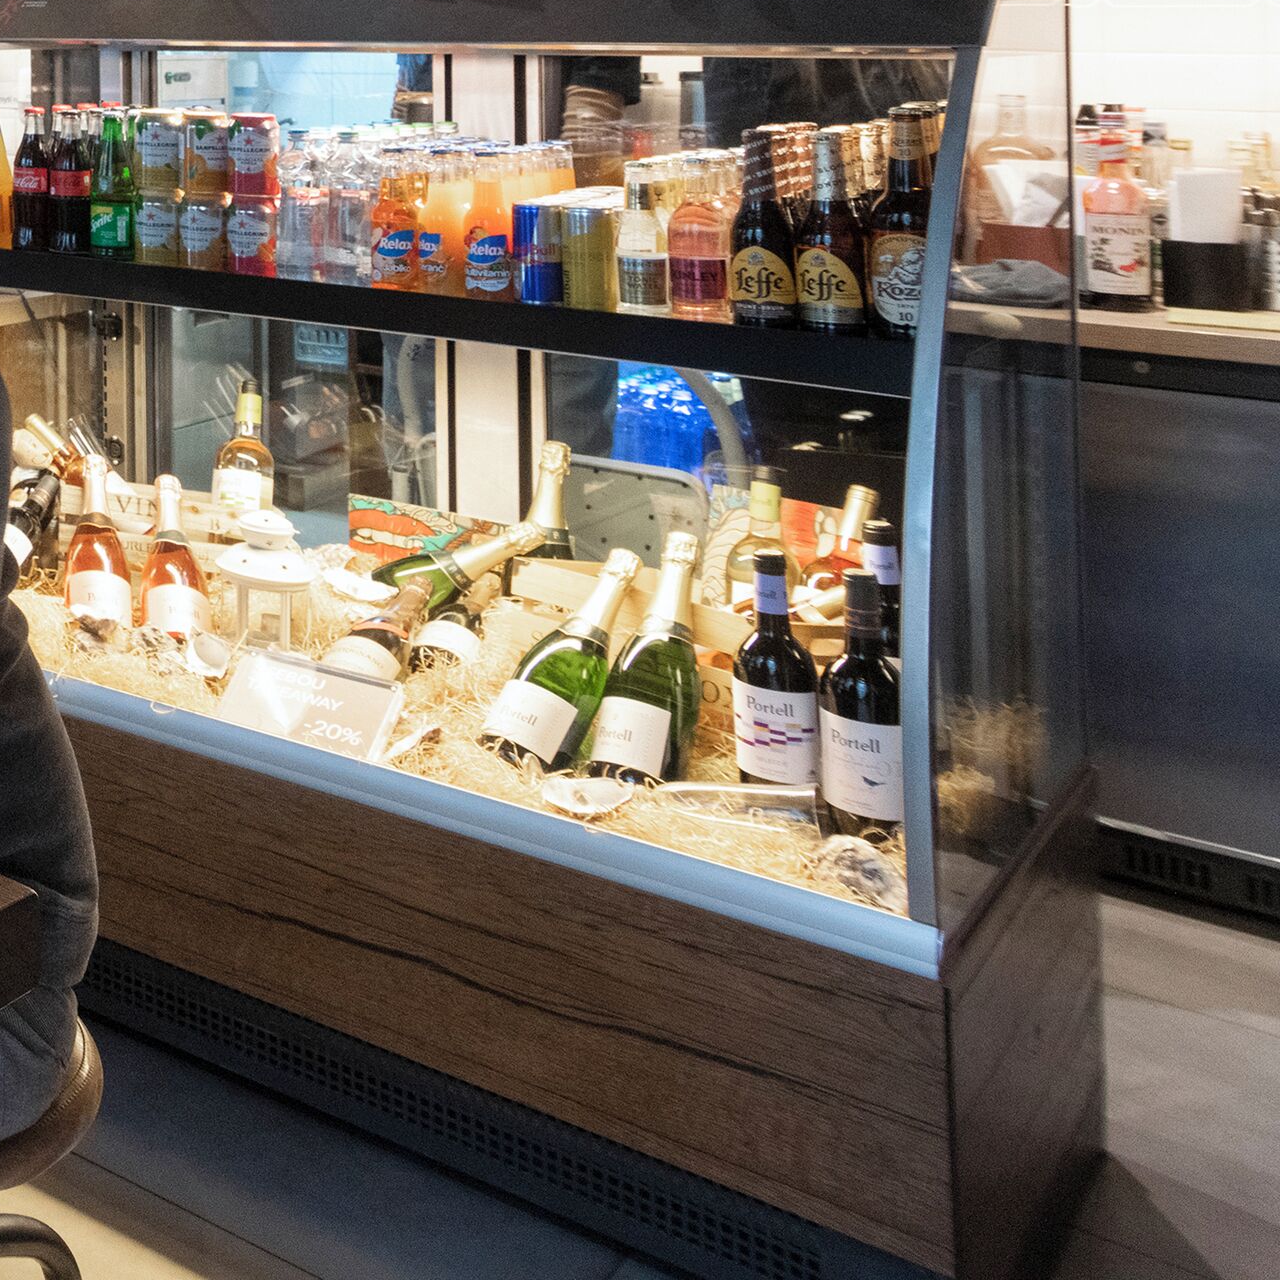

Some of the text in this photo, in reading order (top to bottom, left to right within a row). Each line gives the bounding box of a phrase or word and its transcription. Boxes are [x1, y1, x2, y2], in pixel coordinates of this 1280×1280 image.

[379, 237, 413, 250] Relax
[419, 240, 438, 252] lax
[469, 242, 505, 256] Relax
[735, 267, 785, 299] Leffe
[800, 269, 847, 301] Leffe
[275, 667, 327, 690] EBOU
[499, 704, 539, 728] Portell
[746, 695, 795, 718] Portell
[304, 719, 365, 747] -20%
[599, 727, 633, 743] Portell
[830, 727, 881, 754] Portell
